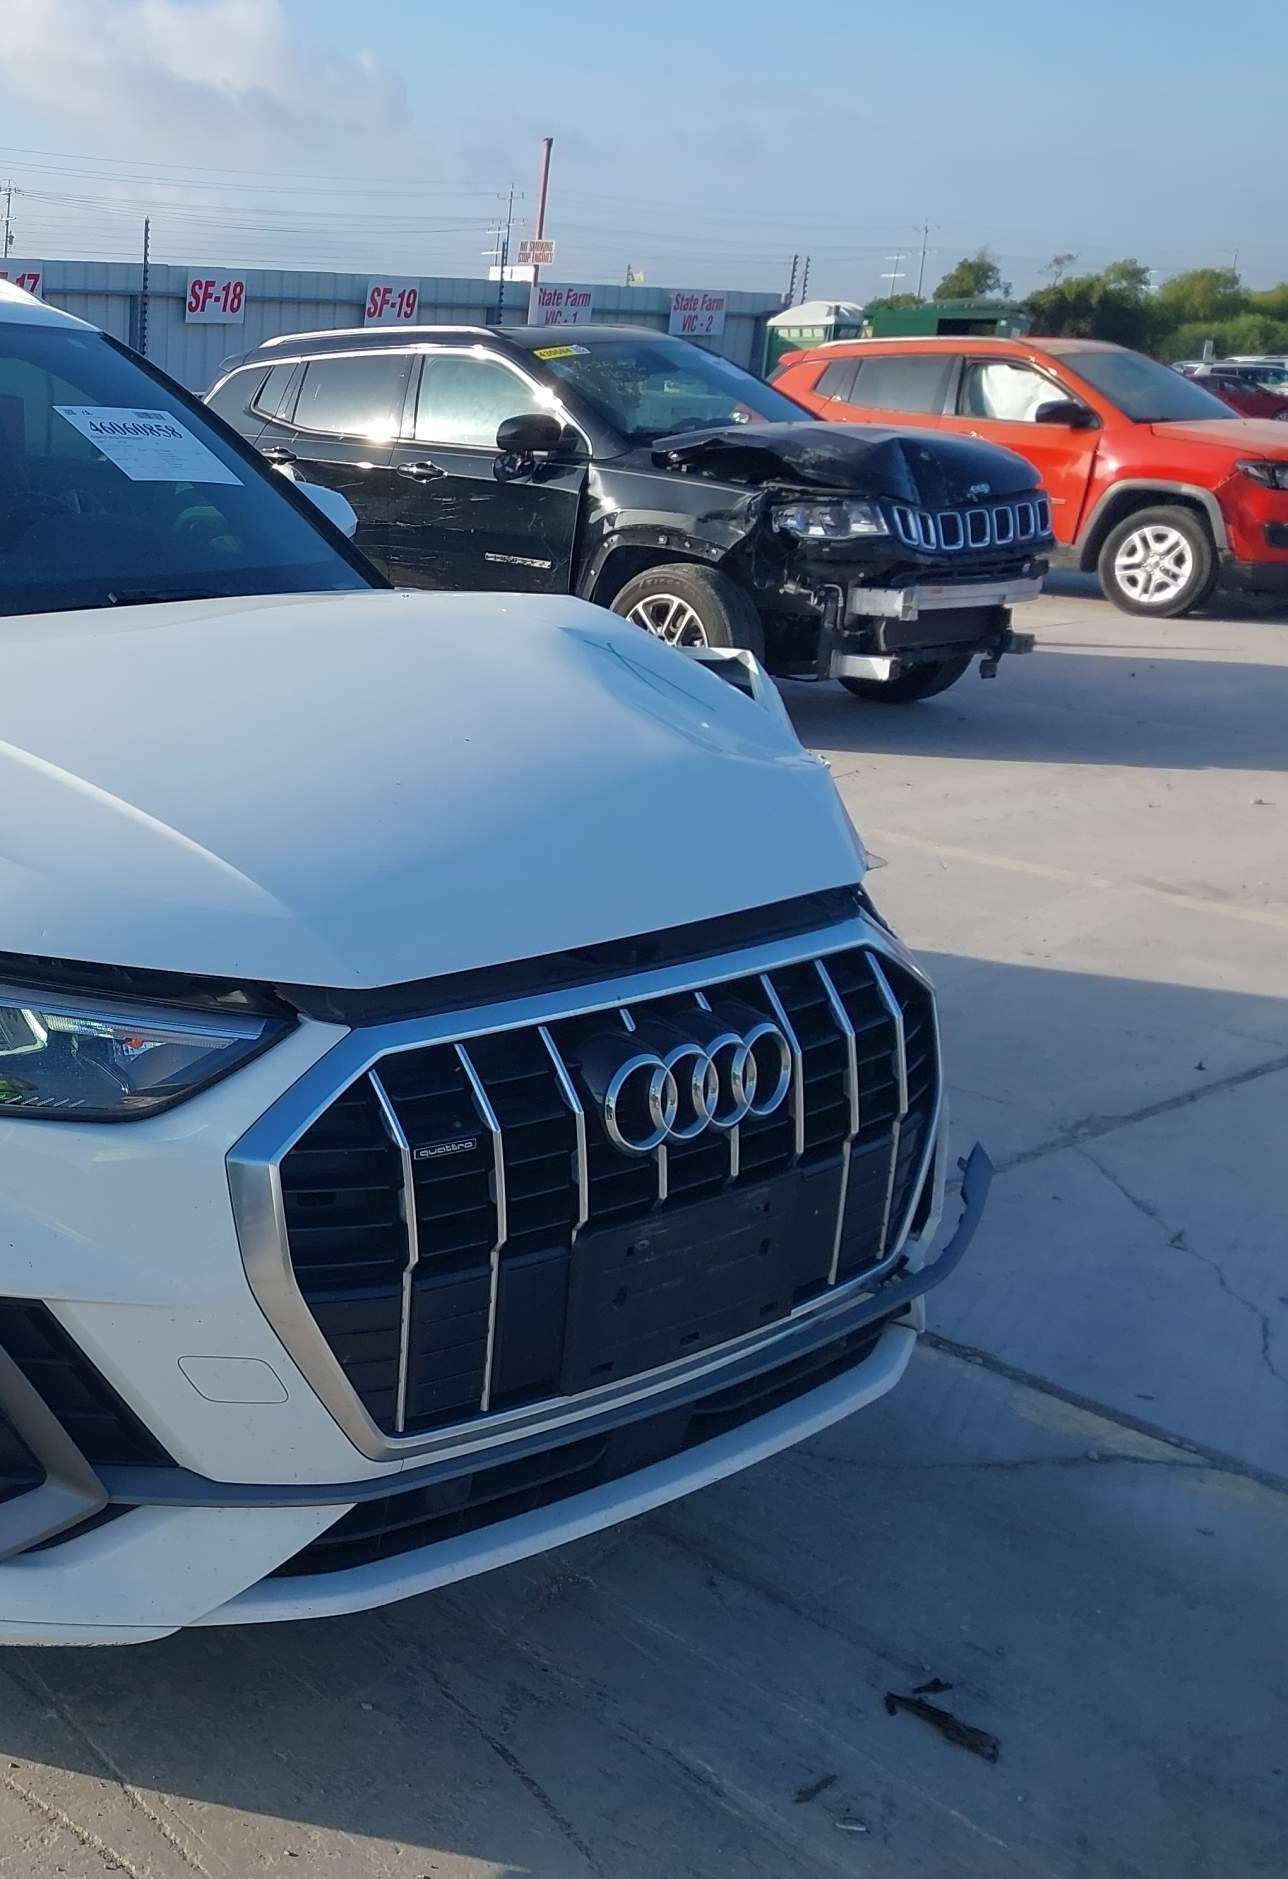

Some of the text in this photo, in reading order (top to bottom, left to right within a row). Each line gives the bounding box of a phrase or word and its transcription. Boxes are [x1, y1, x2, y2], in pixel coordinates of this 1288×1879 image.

[188, 279, 244, 314] SF-18
[367, 287, 418, 319] SF-19
[565, 288, 592, 307] Farm
[673, 293, 724, 312] State Farm
[682, 314, 698, 333] VIC
[705, 314, 714, 332] 2
[89, 420, 184, 440] 46060858
[419, 1141, 473, 1158] quattro
